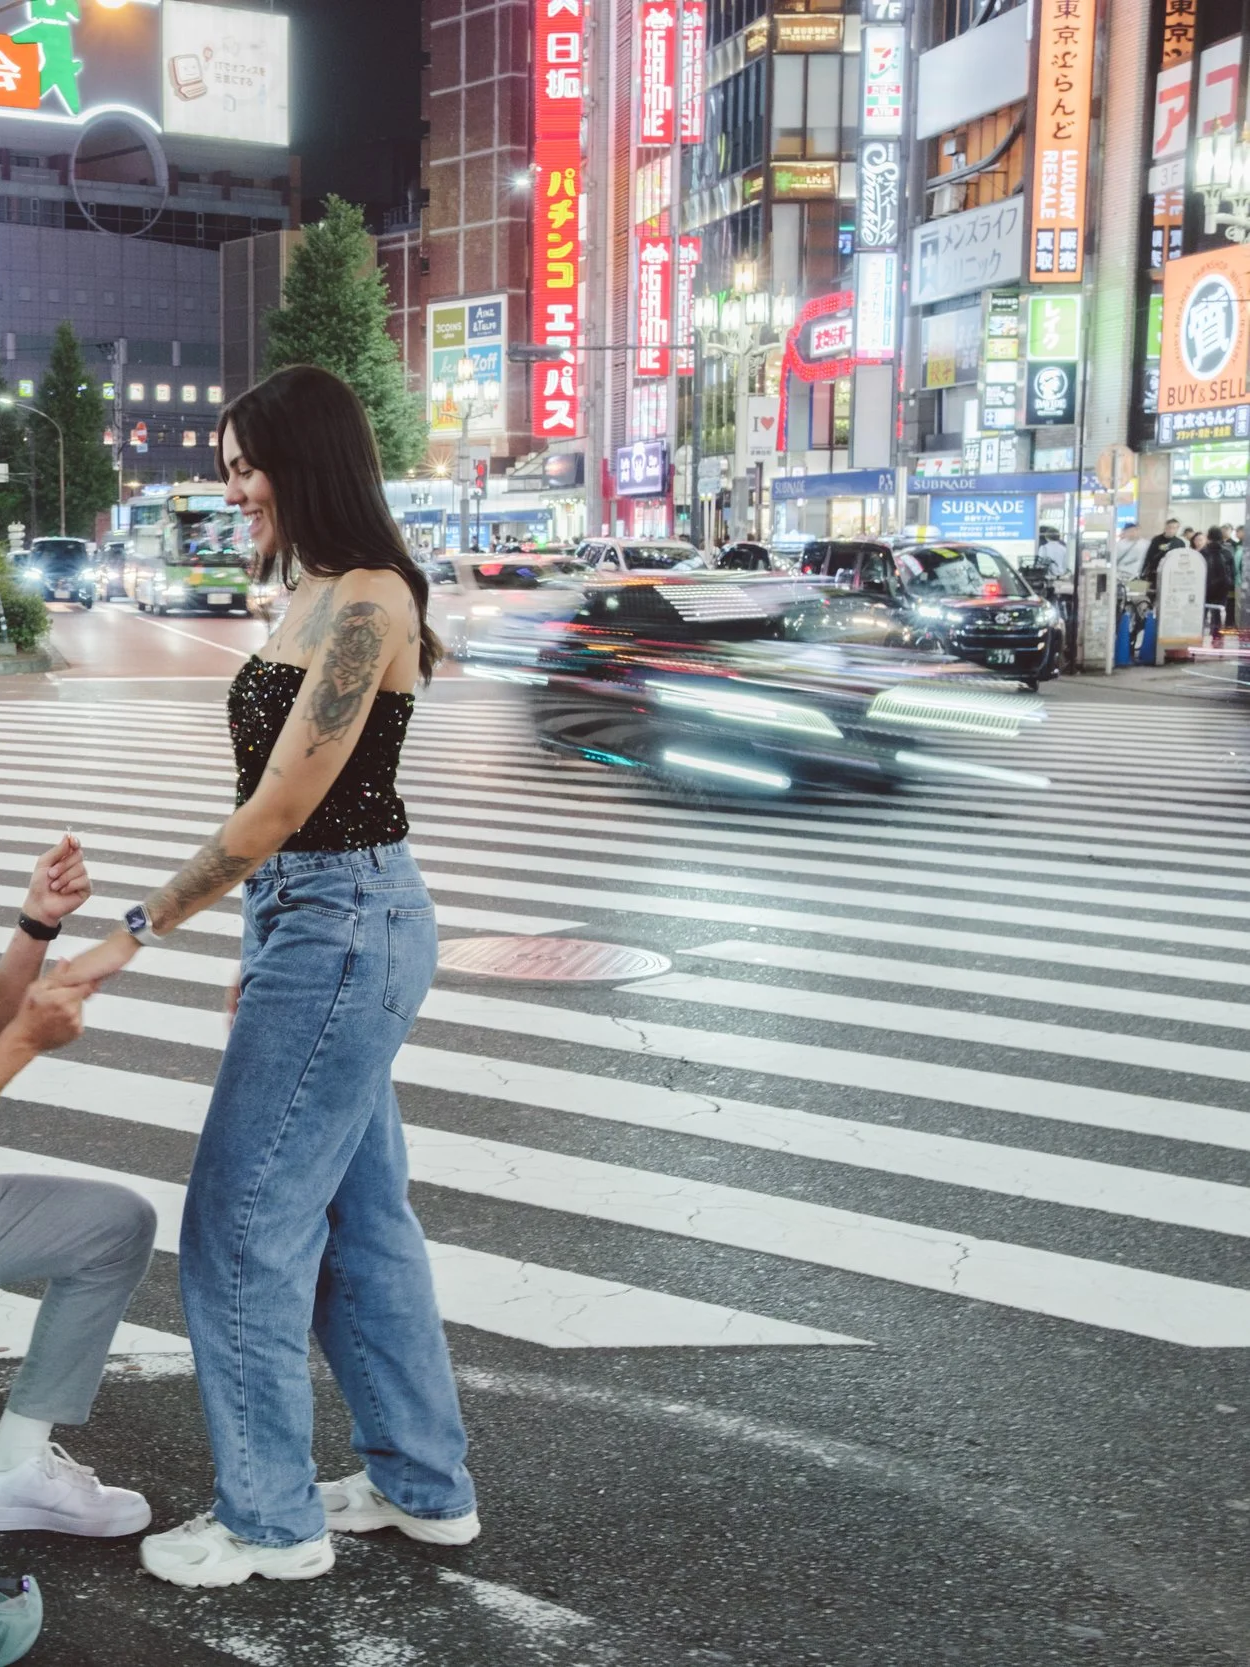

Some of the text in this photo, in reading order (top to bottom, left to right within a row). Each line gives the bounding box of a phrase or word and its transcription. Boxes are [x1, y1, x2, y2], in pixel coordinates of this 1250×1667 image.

[1039, 150, 1059, 220] RESALE
[1059, 150, 1079, 220] LUXURY
[1160, 164, 1179, 186] 3F
[547, 168, 577, 289] パチンコ
[941, 208, 1018, 255] メンズライフ
[1042, 300, 1061, 350] レイク
[1188, 287, 1231, 371] 質
[473, 352, 498, 371] Zoff
[1167, 384, 1198, 407] BUY
[1210, 378, 1246, 402] SELL
[775, 481, 806, 495] SUBNADE
[914, 478, 976, 491] SUBNADE
[941, 500, 1024, 516] SUBNADE
